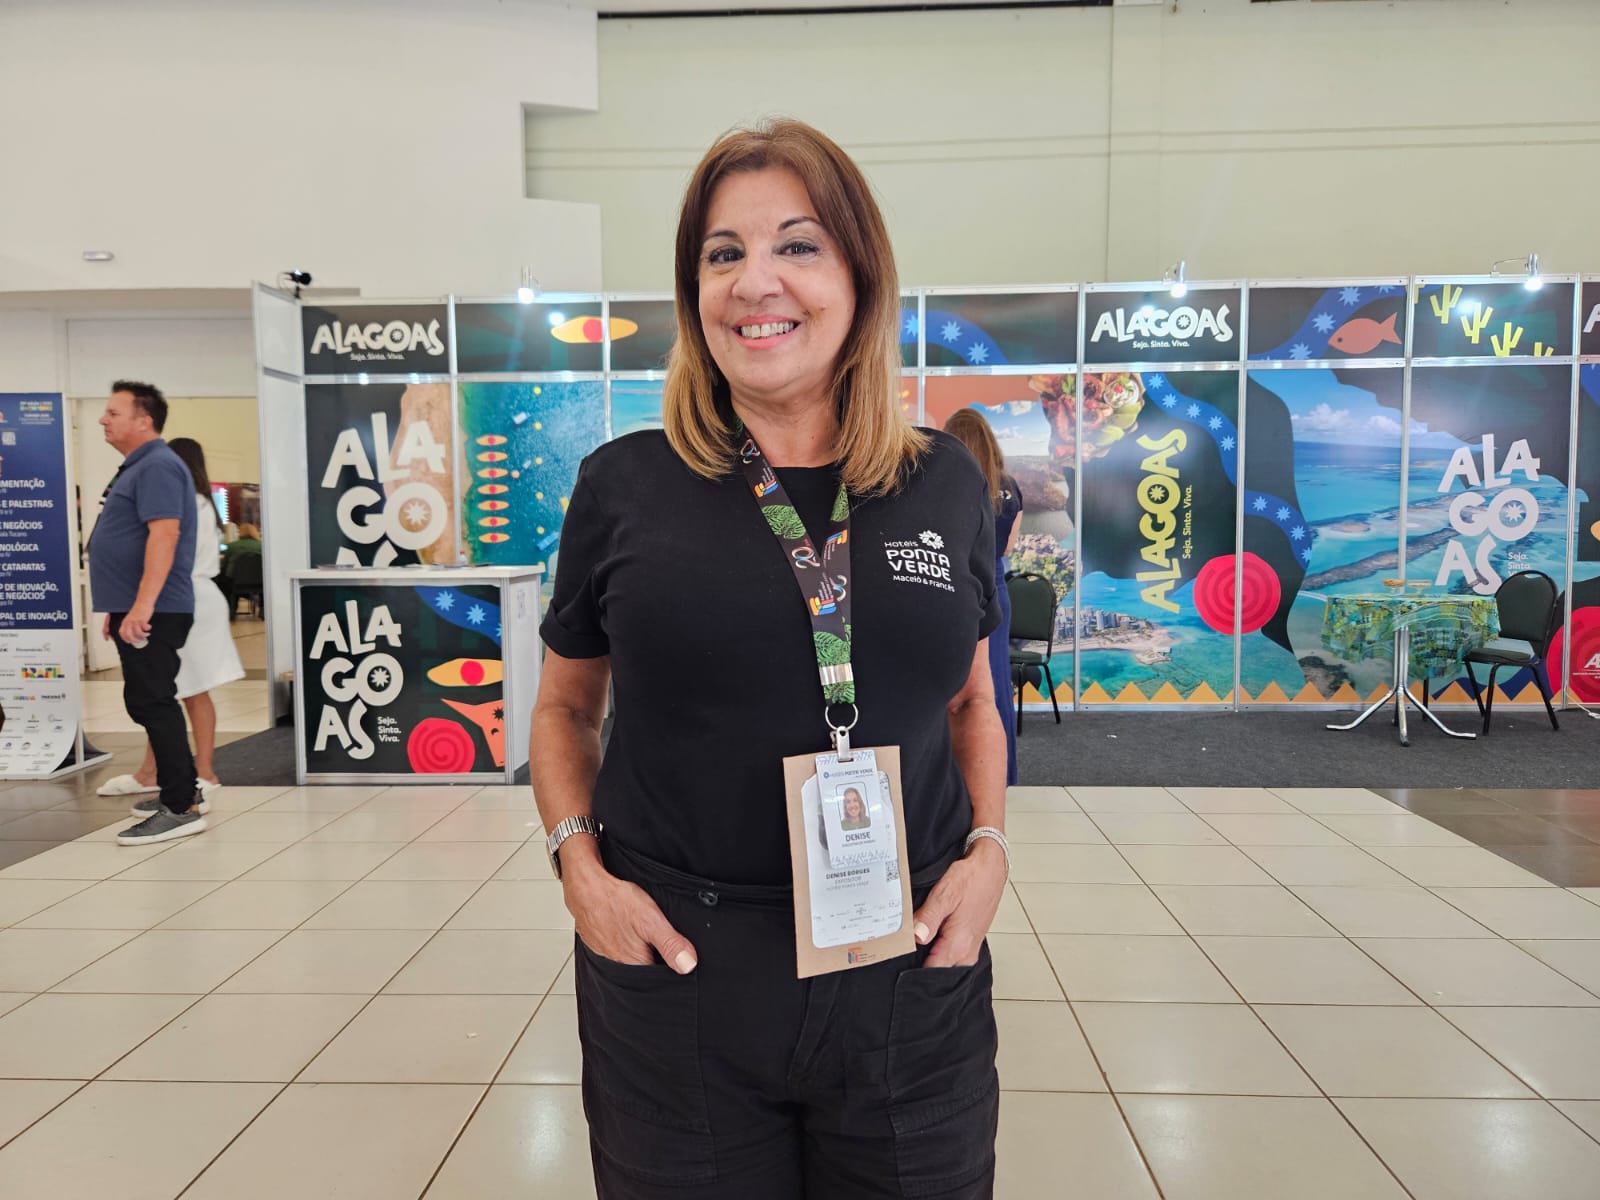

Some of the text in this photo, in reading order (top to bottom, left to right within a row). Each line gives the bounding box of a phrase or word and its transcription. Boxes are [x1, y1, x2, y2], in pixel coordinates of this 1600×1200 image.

[310, 318, 445, 356] ALAGOAS
[1090, 304, 1233, 342] ALAGOAS
[1133, 339, 1190, 350] Seja. Sinta. Viva.
[321, 412, 446, 488] ALA
[1437, 433, 1540, 493] ALA
[9, 500, 54, 508] PALESTRAS
[336, 482, 448, 550] GO
[1449, 488, 1539, 541] GO
[1136, 428, 1187, 614] ALAGOAS
[1182, 484, 1192, 559] Seja. Sinta. Viva.
[2, 563, 46, 571] CATARATAS
[886, 549, 950, 567] PONTA
[888, 560, 951, 581] VERDE
[1435, 534, 1502, 595] AS
[1508, 552, 1529, 560] Seja.
[893, 575, 921, 583] Maceió
[16, 612, 28, 620] DE
[28, 610, 68, 622] INOVAÇÃO
[309, 600, 402, 659] ALA
[321, 652, 404, 706] GO
[314, 699, 375, 759] AS
[377, 717, 397, 726] Seja.
[378, 726, 402, 734] Sinta.
[379, 733, 400, 742] Viva.
[845, 832, 871, 842] DENISE
